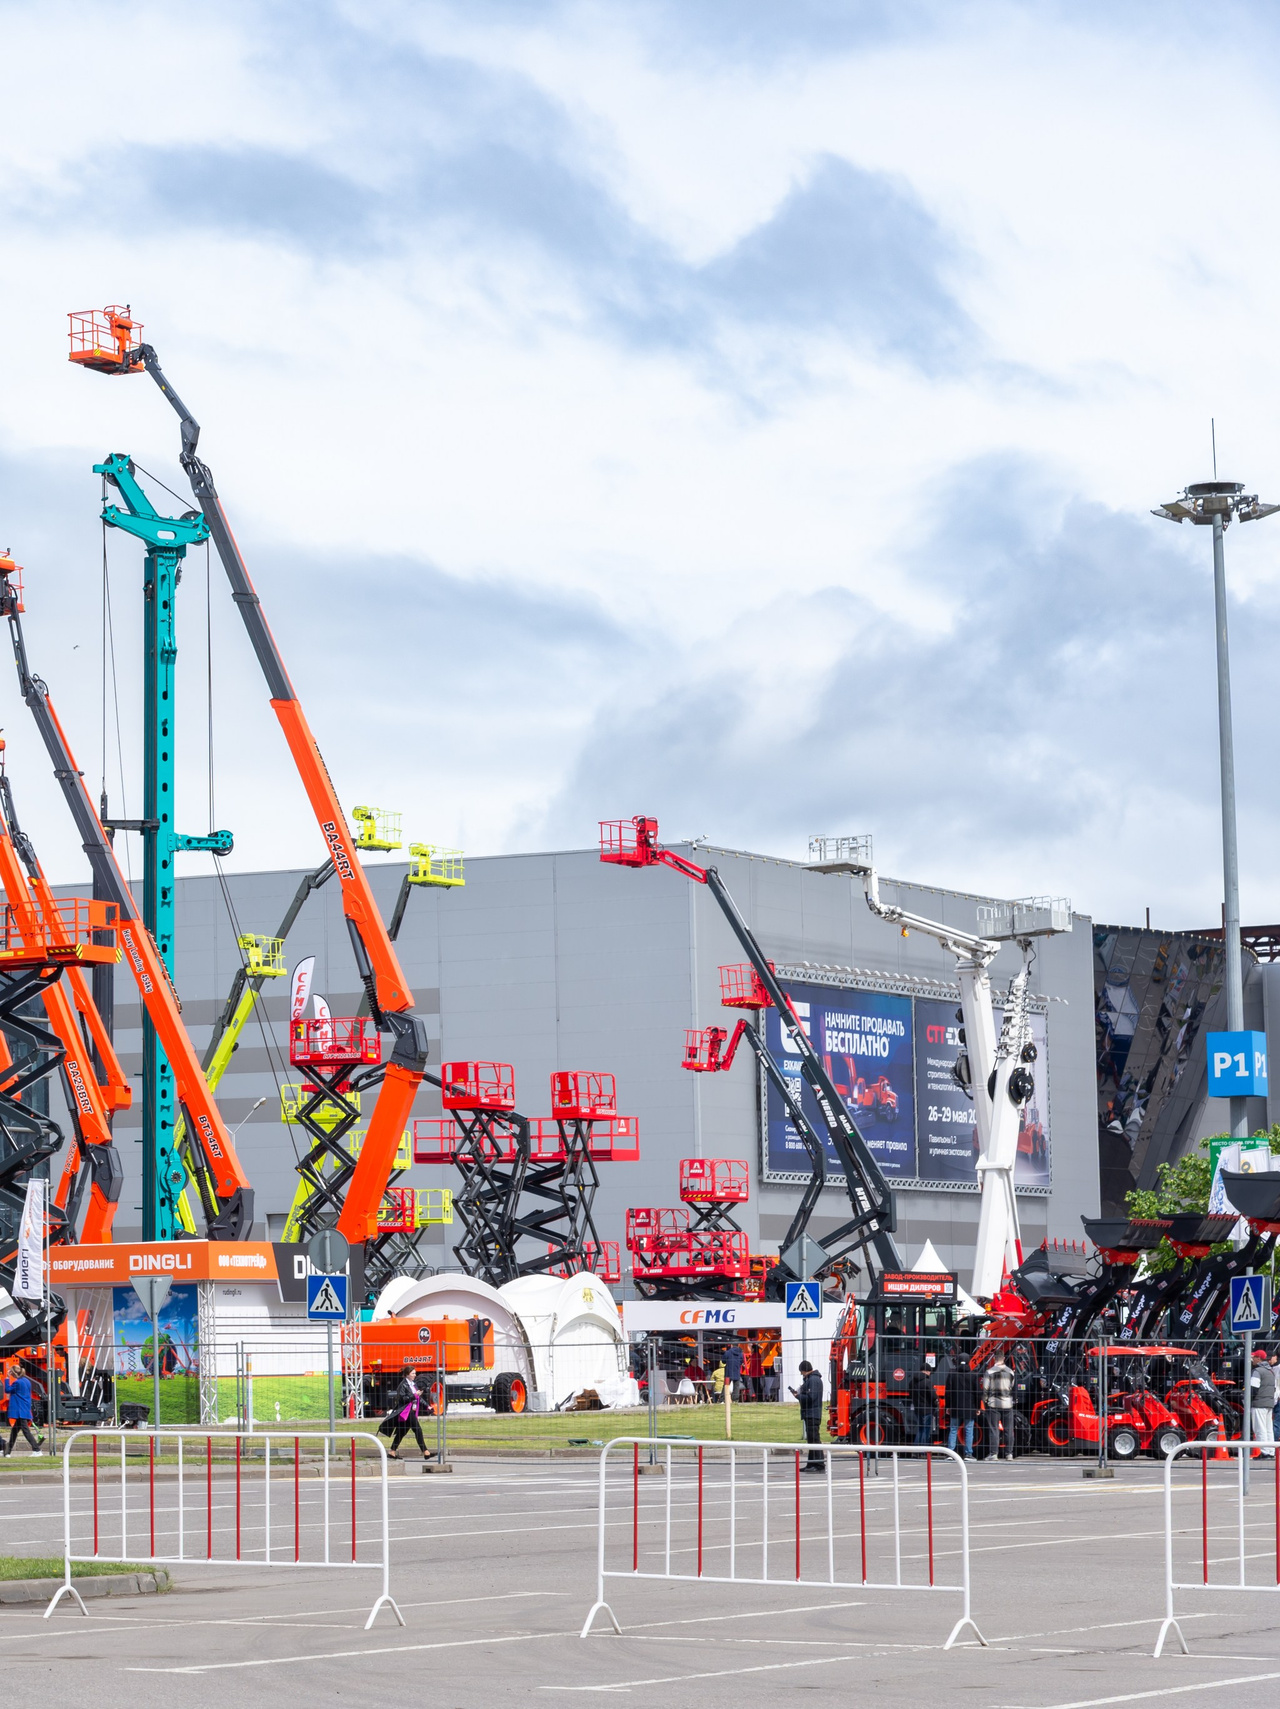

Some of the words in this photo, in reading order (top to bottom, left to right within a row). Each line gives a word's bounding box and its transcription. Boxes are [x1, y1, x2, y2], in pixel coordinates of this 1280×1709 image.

[322, 821, 355, 880] BA44RT
[140, 973, 153, 993] 454kg
[293, 972, 307, 1020] CFMG
[825, 1011, 861, 1031] НАЧНИТЕ
[861, 1017, 905, 1037] ПРОДАВАТЬ
[1214, 1052, 1249, 1078] P1
[1254, 1051, 1267, 1078] P1
[67, 1061, 94, 1114] BA28BRT
[820, 1099, 838, 1128] HERED
[953, 1111, 967, 1123] мая
[198, 1115, 224, 1159] BT34RT
[886, 1141, 907, 1153] правила
[53, 1259, 114, 1271] ОБОРУДОВАНИЕ
[129, 1253, 192, 1271] DINGLI
[884, 1273, 953, 1281] ЗАВОД-ПРОИЗВОДИТЕЛЬ
[887, 1283, 908, 1291] ИЩЕМ
[680, 1309, 736, 1324] CFMG
